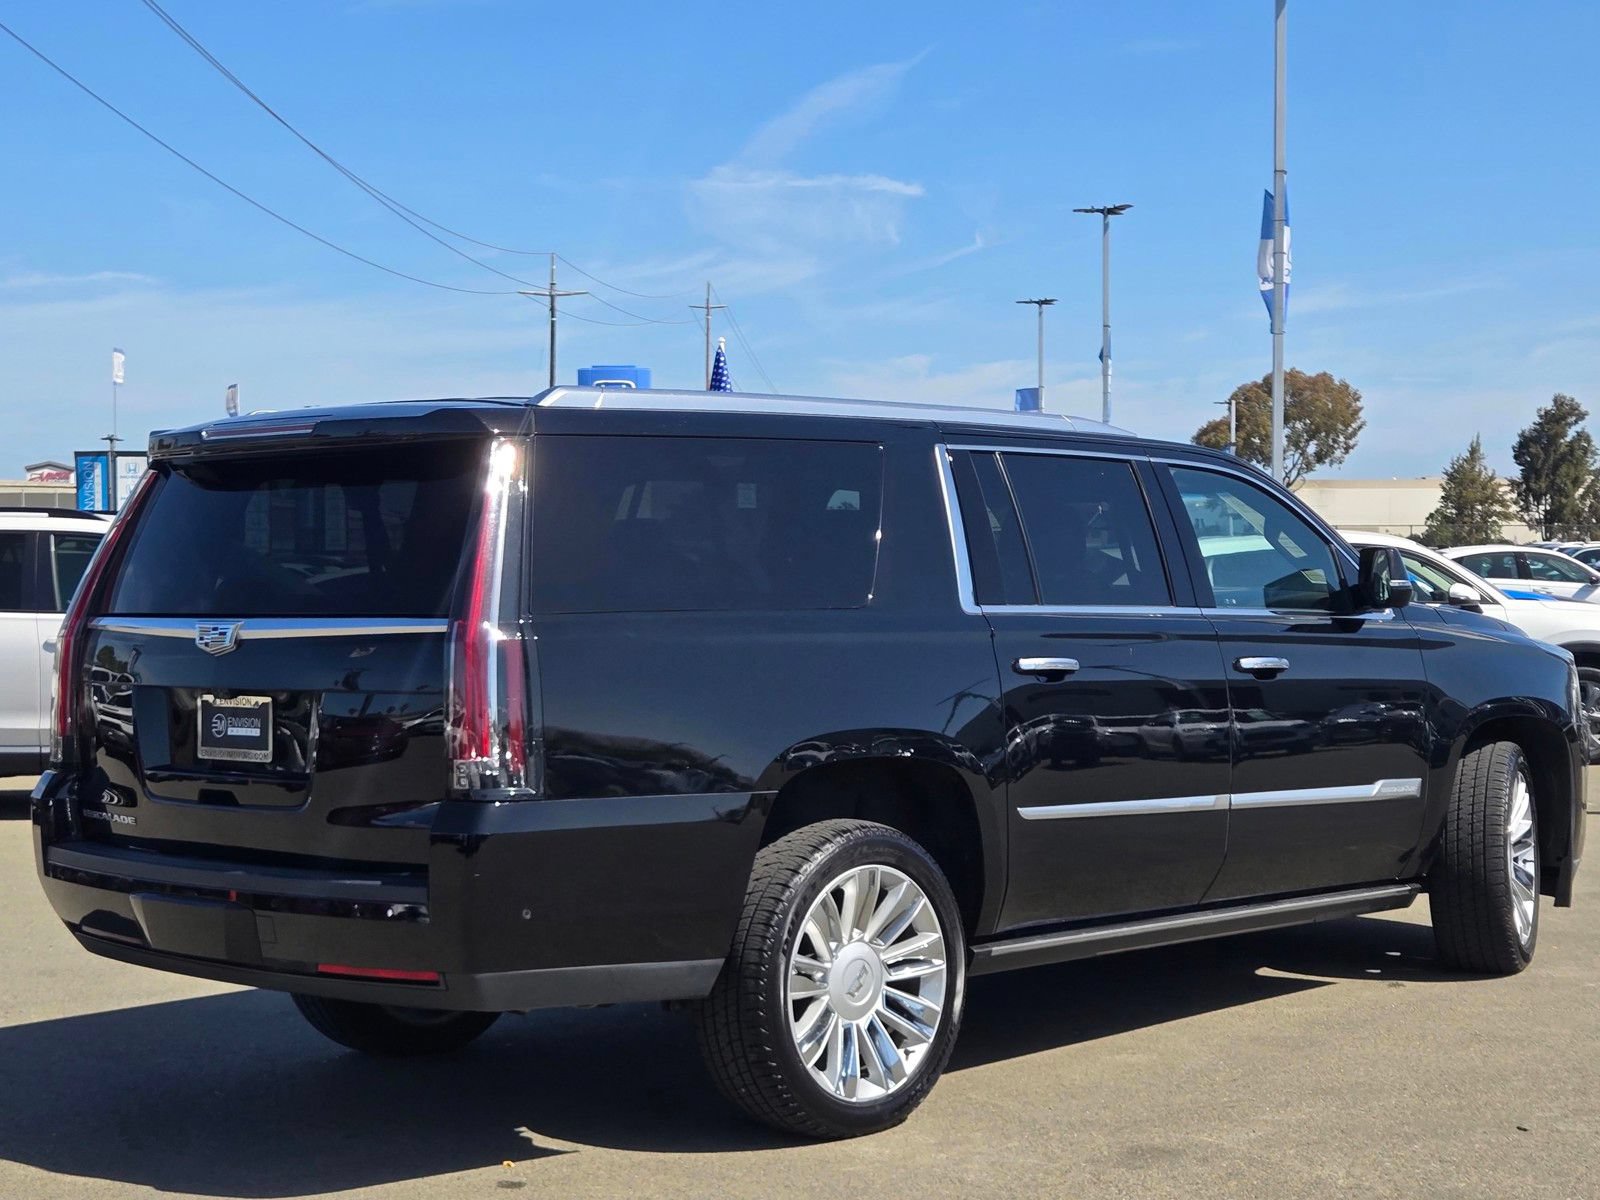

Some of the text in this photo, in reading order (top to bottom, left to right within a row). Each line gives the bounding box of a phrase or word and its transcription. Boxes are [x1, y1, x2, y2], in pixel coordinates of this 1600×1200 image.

[83, 461, 95, 510] NVISION
[219, 697, 252, 707] ENVISION
[227, 716, 261, 728] ENVISION
